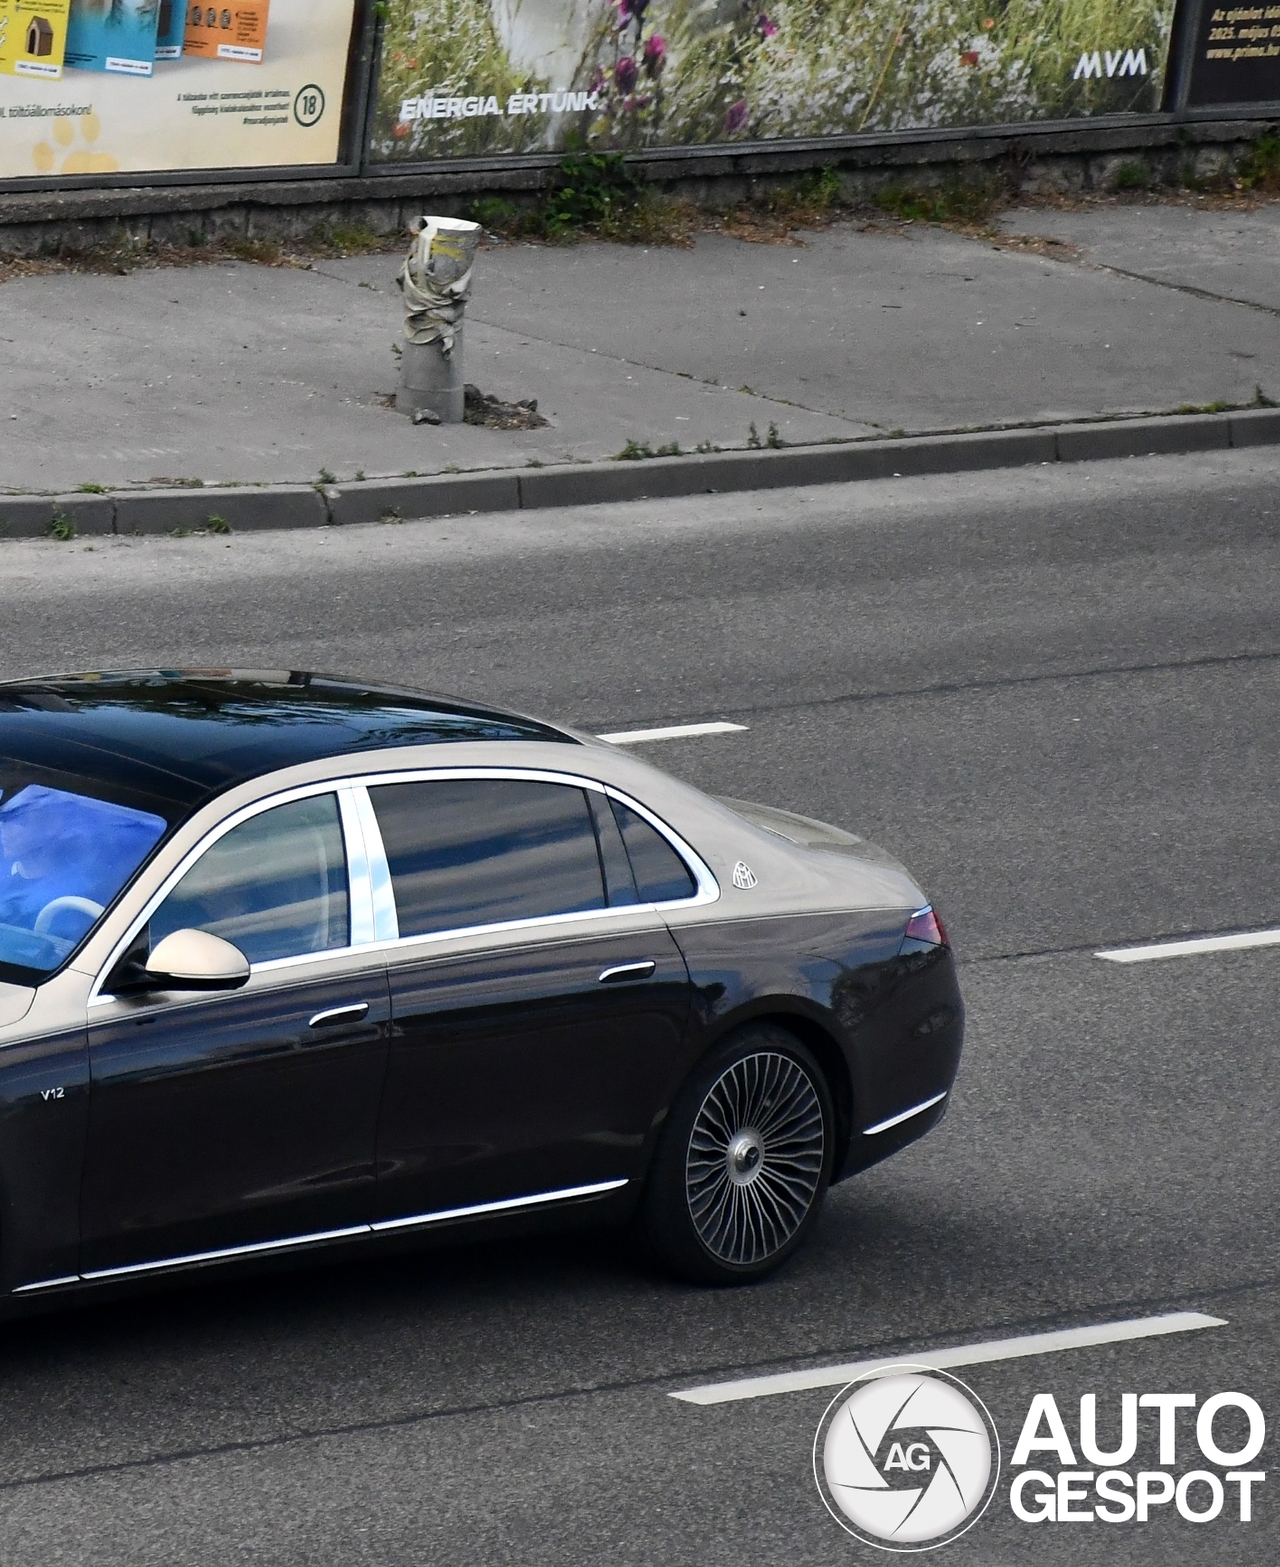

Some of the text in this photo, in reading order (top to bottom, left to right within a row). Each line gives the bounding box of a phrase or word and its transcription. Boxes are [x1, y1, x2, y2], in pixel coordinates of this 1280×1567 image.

[1073, 48, 1147, 79] MVM
[302, 95, 317, 116] 18
[40, 1086, 65, 1101] V12
